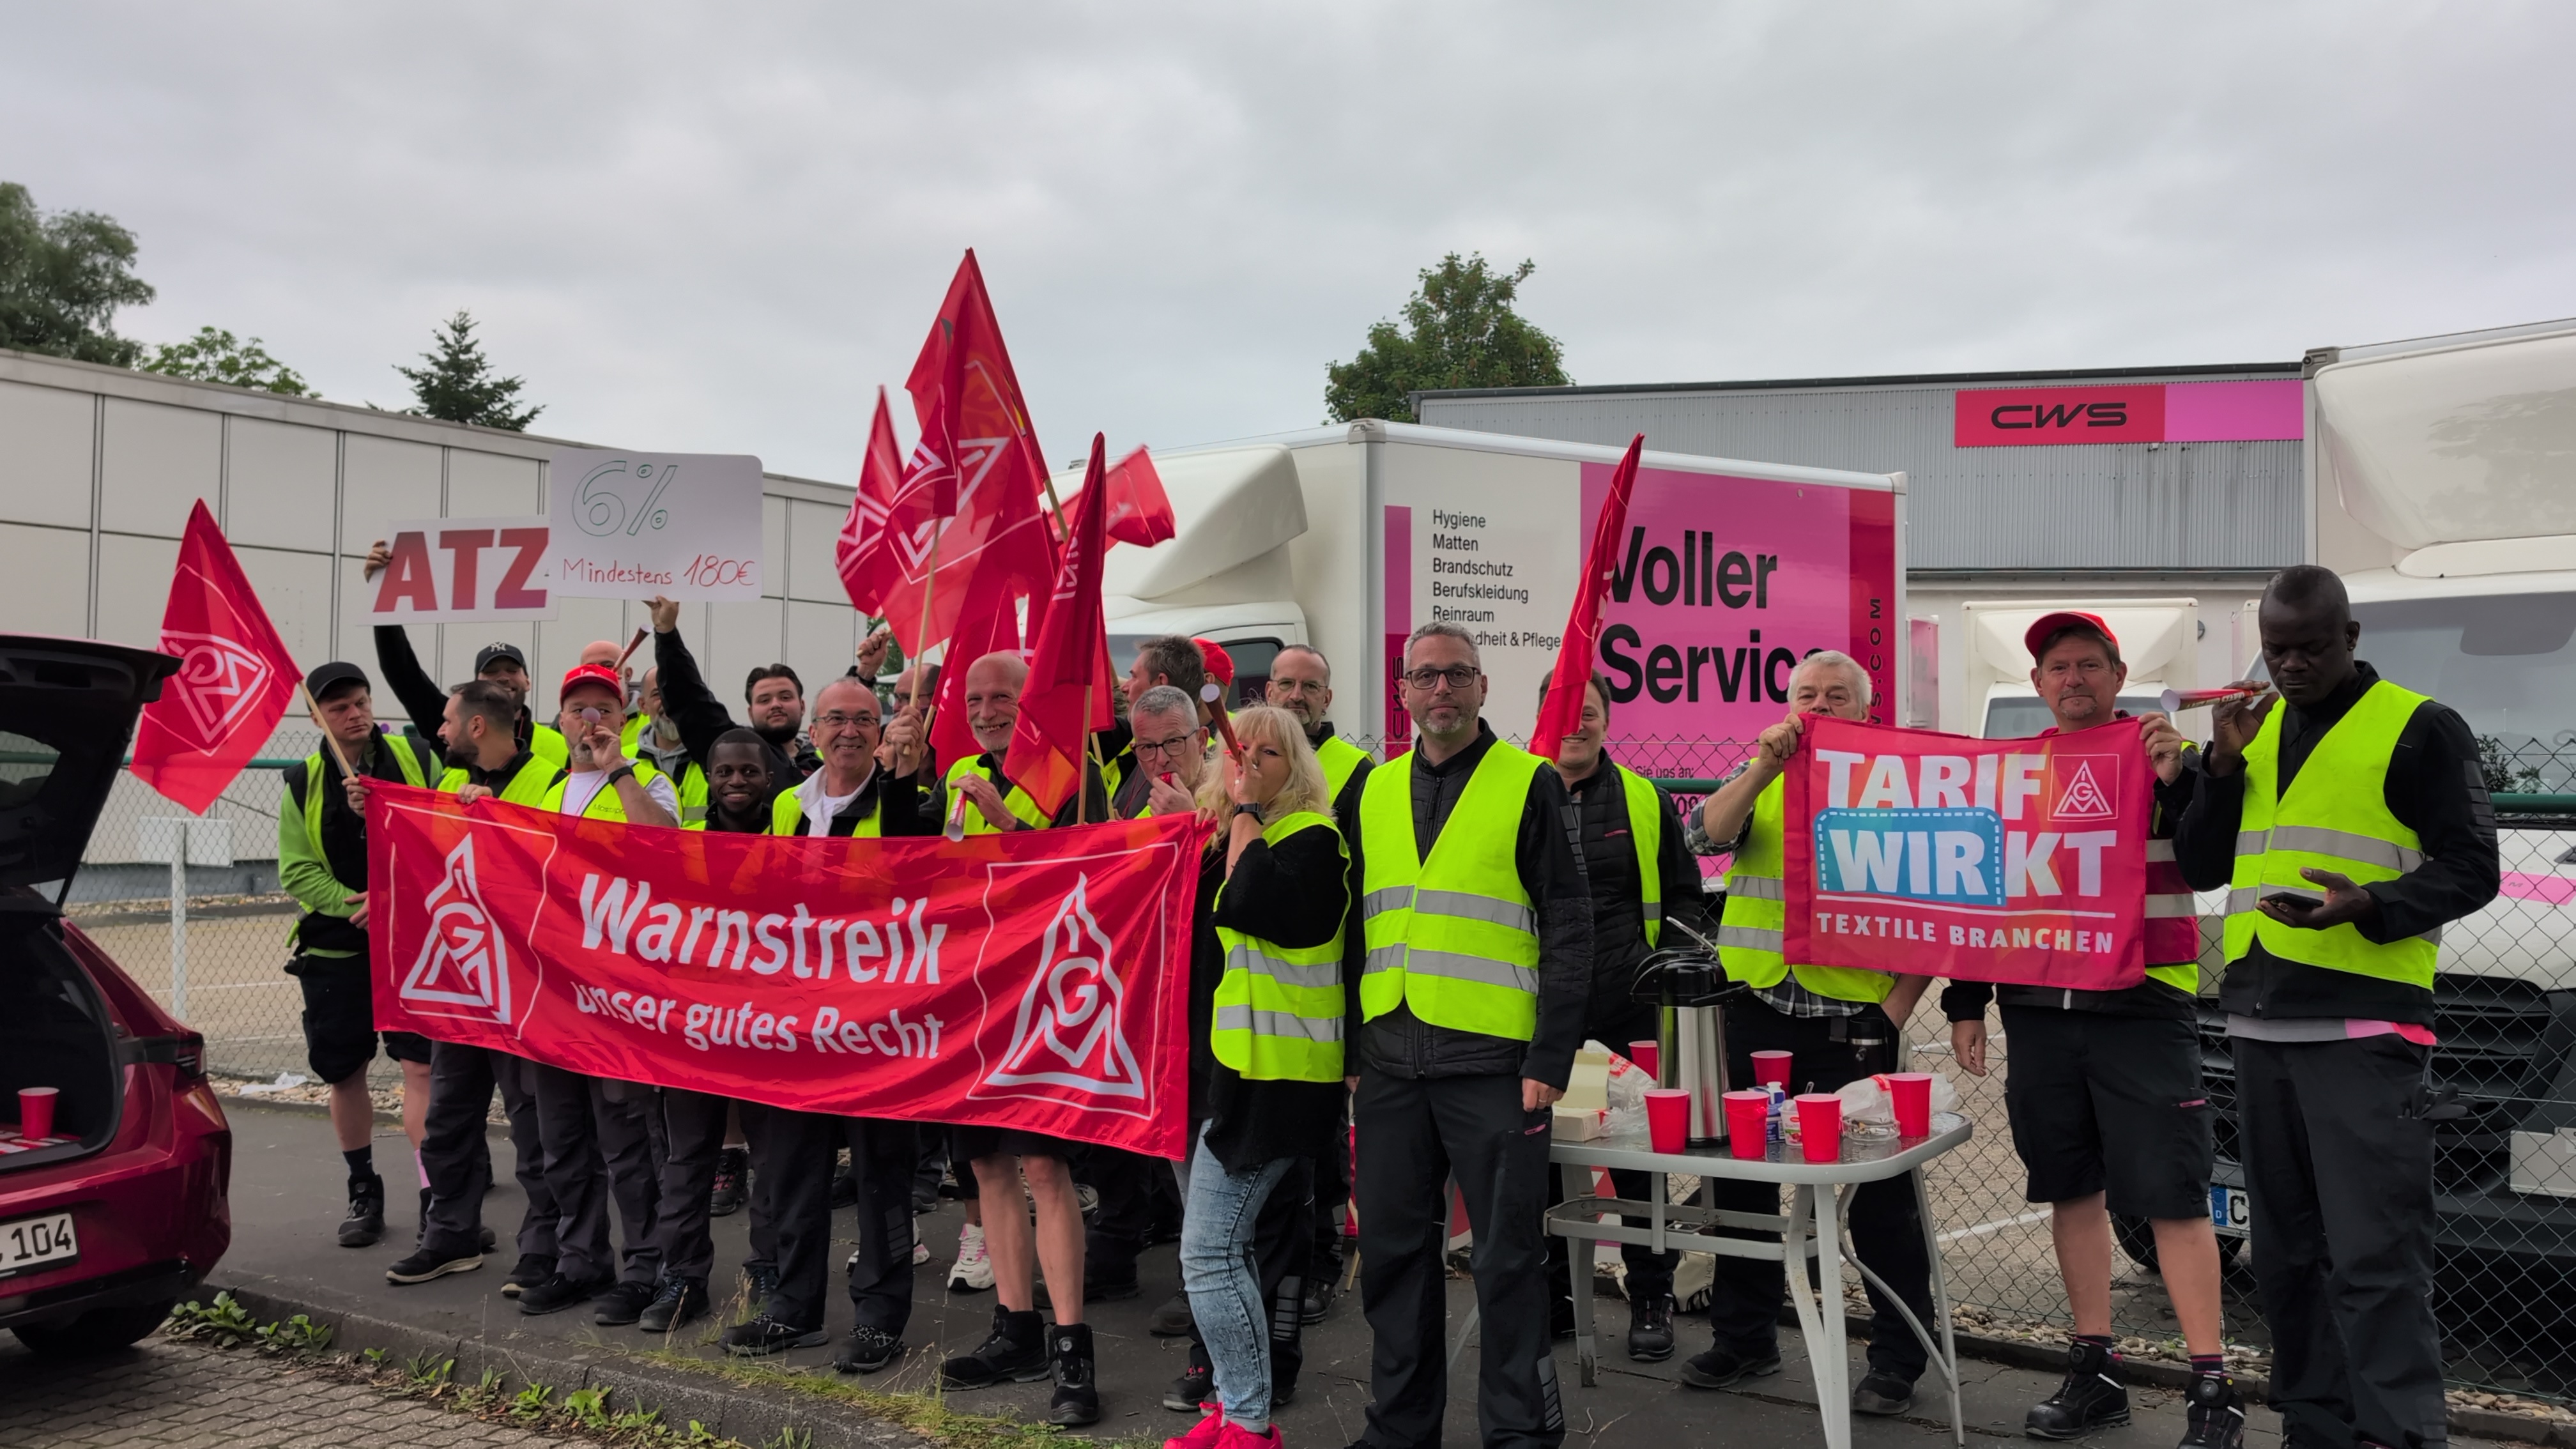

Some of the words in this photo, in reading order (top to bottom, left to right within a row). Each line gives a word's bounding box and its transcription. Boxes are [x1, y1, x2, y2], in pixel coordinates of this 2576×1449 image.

[1991, 402, 2127, 429] CWS
[572, 461, 678, 536] 6%
[1433, 509, 1486, 530] Hygiene
[1433, 533, 1478, 551] Matten
[372, 527, 549, 613] ATZ
[563, 558, 672, 585] Mindestens
[684, 555, 755, 587] 180€
[1433, 557, 1513, 577] Brandschutz
[1611, 526, 1777, 609] Voller
[1433, 581, 1529, 604] Berufskleidung
[1433, 605, 1494, 623] Reinraum
[1510, 632, 1519, 647] &
[1522, 632, 1561, 650] Pflege
[1600, 624, 1826, 703] Servic
[1816, 749, 2046, 820] TARIF
[1828, 829, 2117, 898] WIRKT
[579, 873, 948, 985] Warnstreik
[1816, 912, 1936, 942] TEXTILE
[1949, 925, 2113, 954] BRANCHEN
[569, 981, 677, 1034] unser
[684, 1001, 798, 1052] gutes
[811, 1006, 944, 1059] Recht
[2230, 1195, 2247, 1224] C
[11, 1218, 72, 1262] 104
